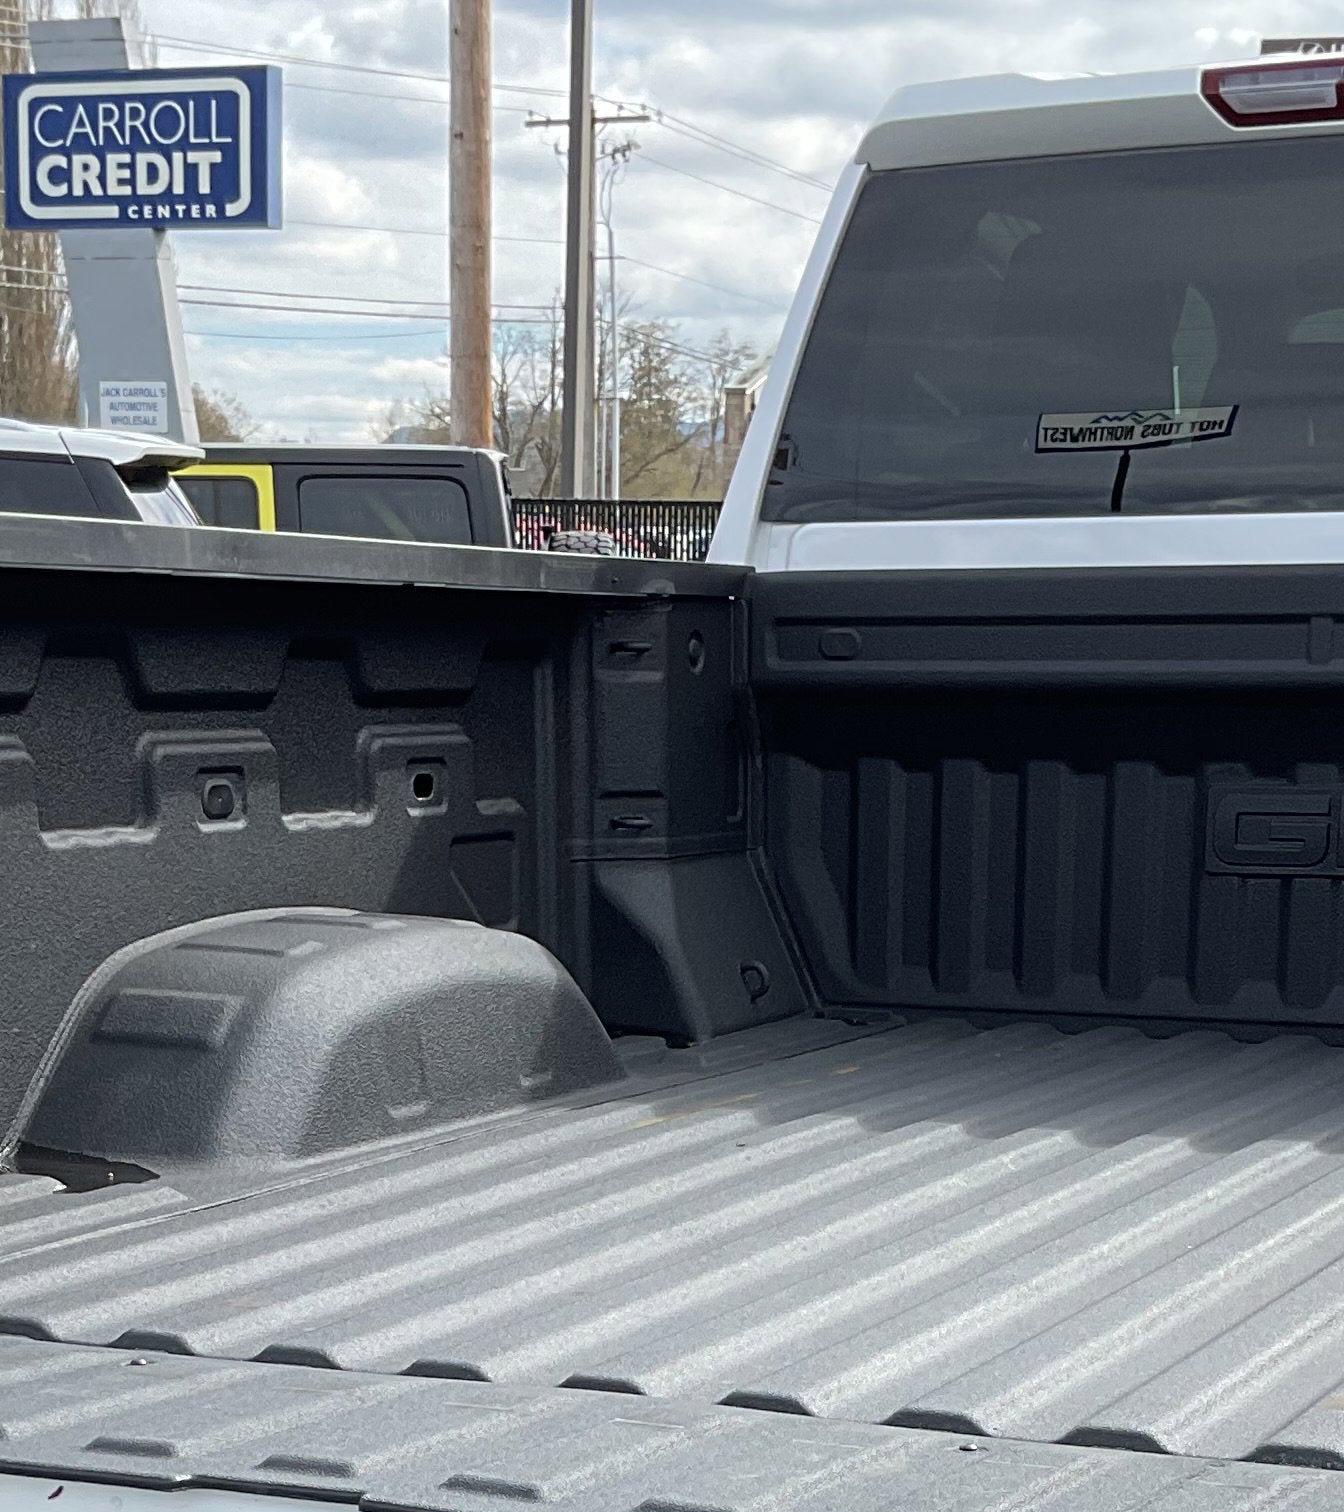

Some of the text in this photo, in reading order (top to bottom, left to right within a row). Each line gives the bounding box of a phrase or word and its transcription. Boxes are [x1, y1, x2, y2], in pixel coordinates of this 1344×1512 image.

[34, 99, 232, 147] CARROLL
[36, 150, 222, 197] CREDIT
[127, 203, 217, 219] CENTER
[101, 387, 121, 397] JACK
[109, 401, 159, 411] AUTOMOTIVE
[110, 416, 158, 426] WHOLESALE
